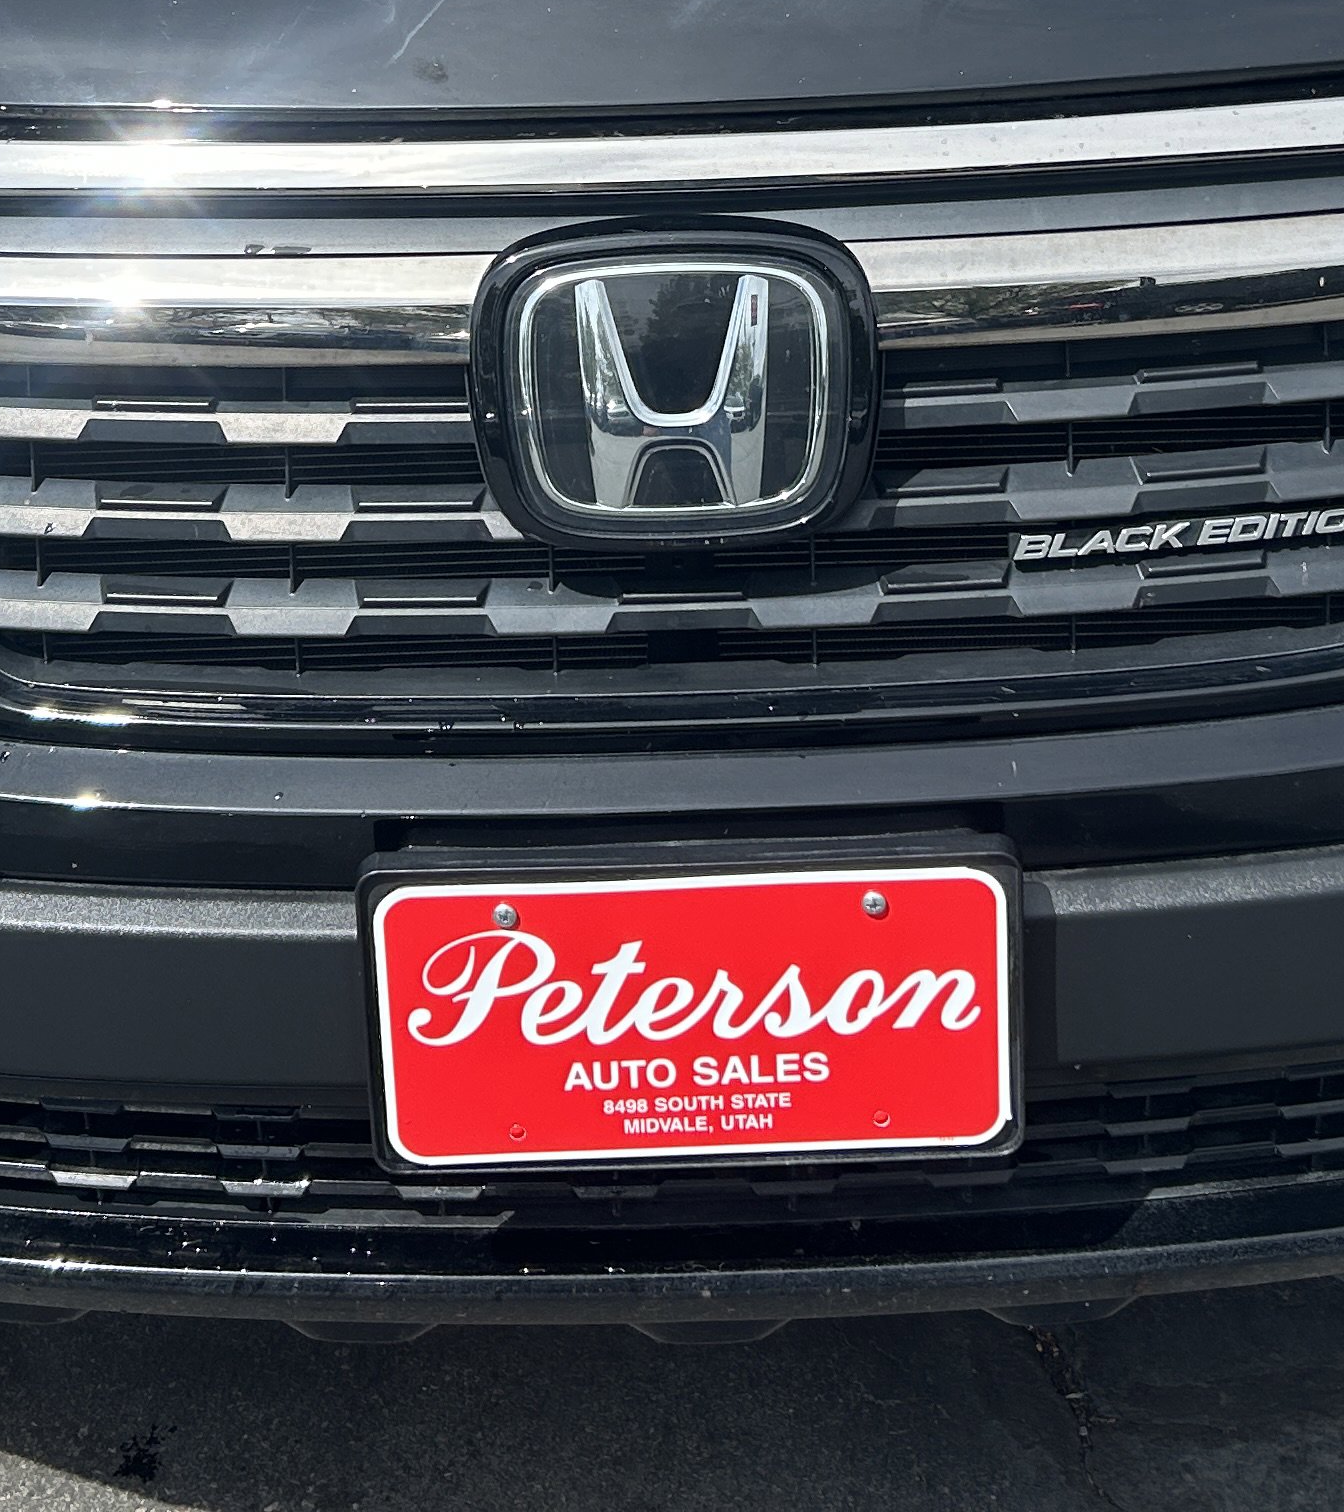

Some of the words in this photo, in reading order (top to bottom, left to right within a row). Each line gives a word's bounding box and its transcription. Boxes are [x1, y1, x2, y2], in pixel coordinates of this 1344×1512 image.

[1013, 521, 1191, 561] BLACK
[407, 929, 981, 1048] Peterson
[564, 1058, 677, 1092] AUTO
[692, 1051, 830, 1086] SALES
[603, 1098, 648, 1115] 8498
[654, 1095, 724, 1113] SOUTH
[730, 1092, 793, 1110] STATE
[623, 1116, 714, 1135] MIDVALE,
[720, 1114, 774, 1132] UTAH
